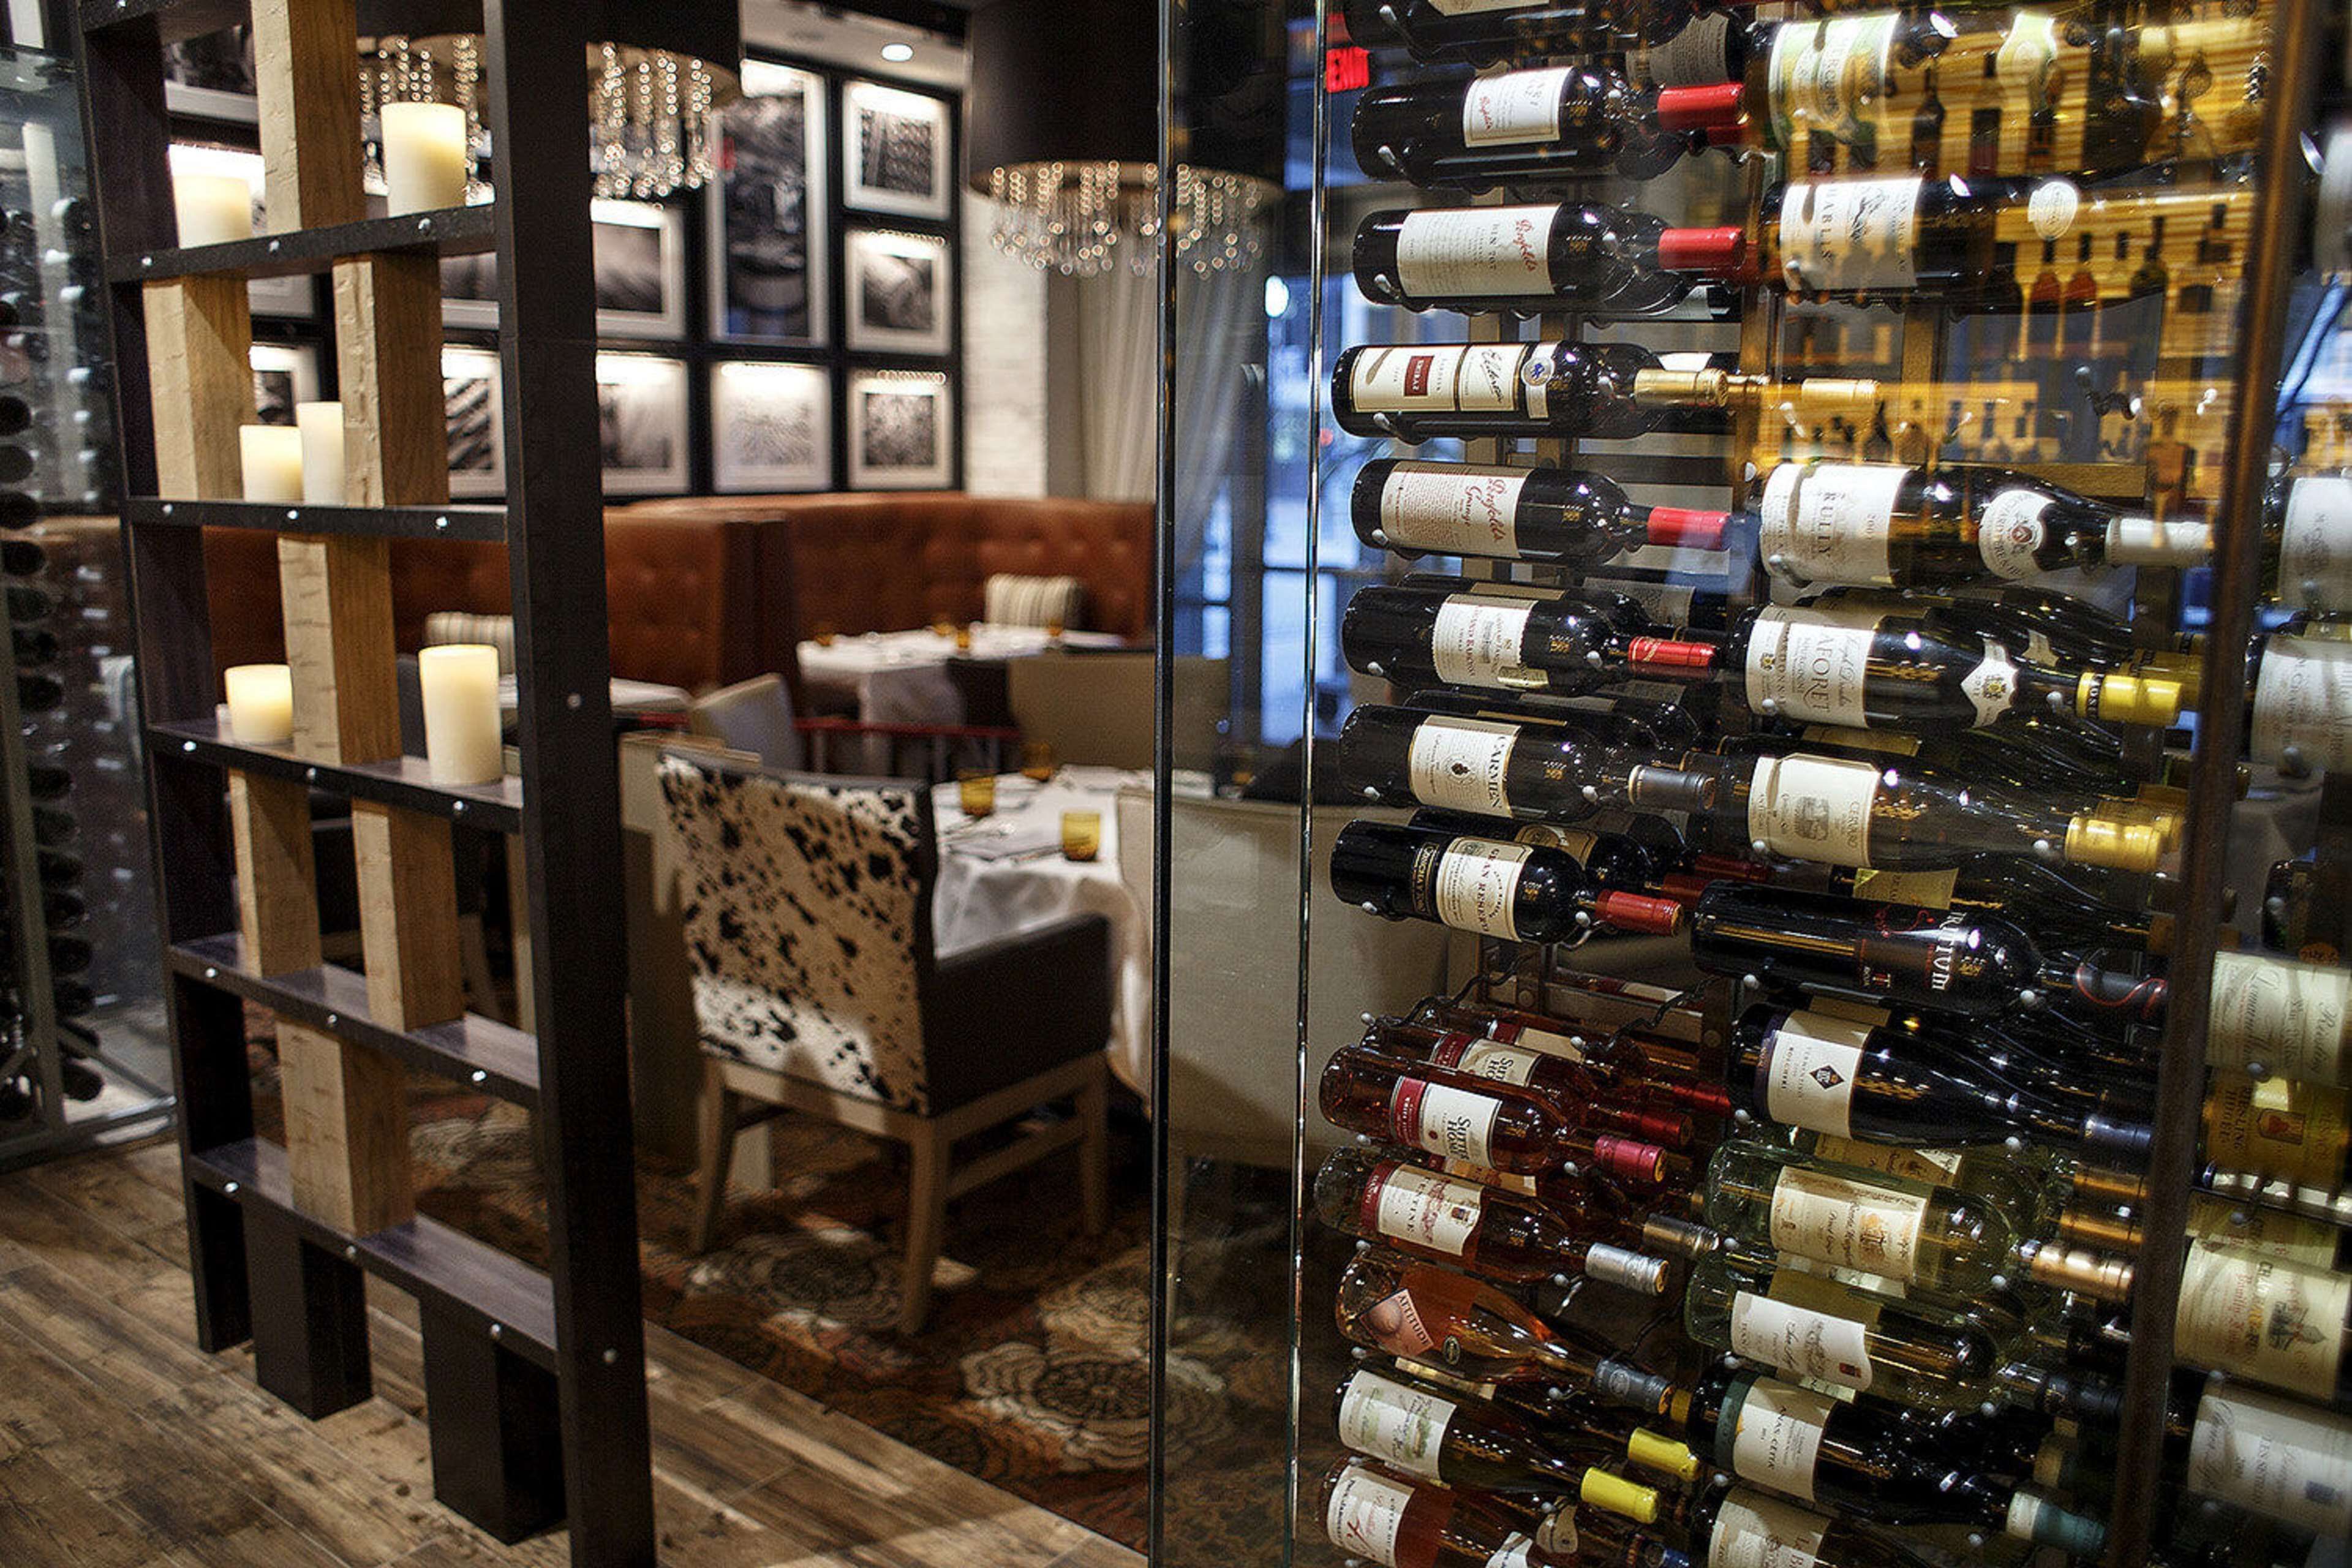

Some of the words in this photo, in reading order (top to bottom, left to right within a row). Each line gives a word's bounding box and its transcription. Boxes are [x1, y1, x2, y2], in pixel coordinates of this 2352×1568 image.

[1460, 485, 1483, 527] Grange
[1480, 477, 1508, 544] Penfolds
[1817, 492, 1838, 558] RULLY
[1803, 637, 1836, 713] AFORET
[1488, 736, 1507, 809] CARMEN
[1447, 1120, 1460, 1156] HOME
[1456, 1115, 1472, 1161] SUTTER
[1397, 1294, 1430, 1348] ATTITUDE
